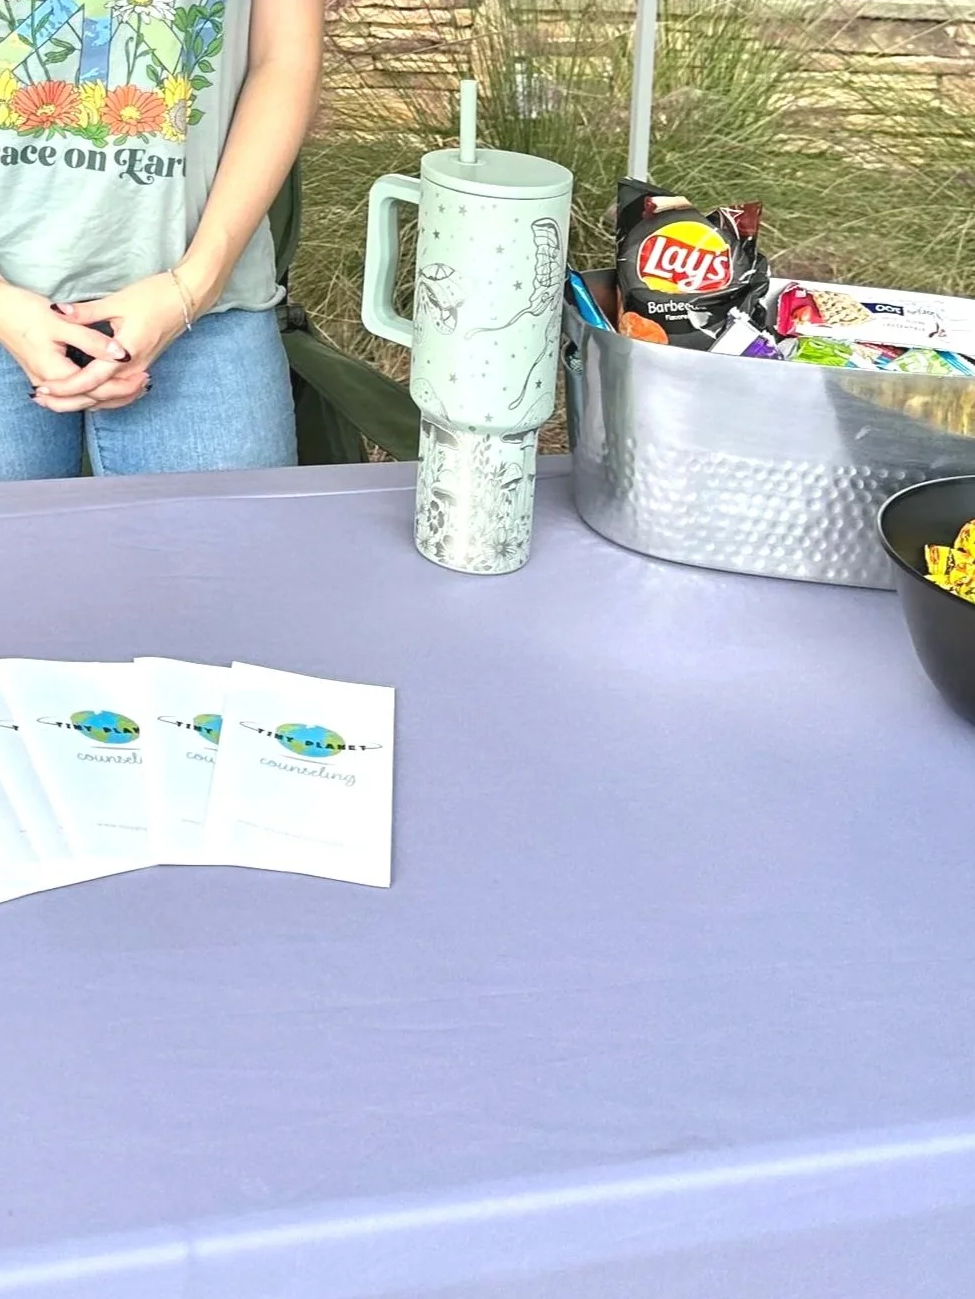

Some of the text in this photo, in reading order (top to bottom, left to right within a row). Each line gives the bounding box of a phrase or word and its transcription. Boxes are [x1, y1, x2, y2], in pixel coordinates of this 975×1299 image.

[64, 148, 107, 172] on
[643, 236, 728, 290] Lay's
[56, 721, 92, 732] TINY
[176, 721, 213, 734] TINY
[257, 728, 367, 751] TINY PLANET
[259, 757, 356, 787] counseling
